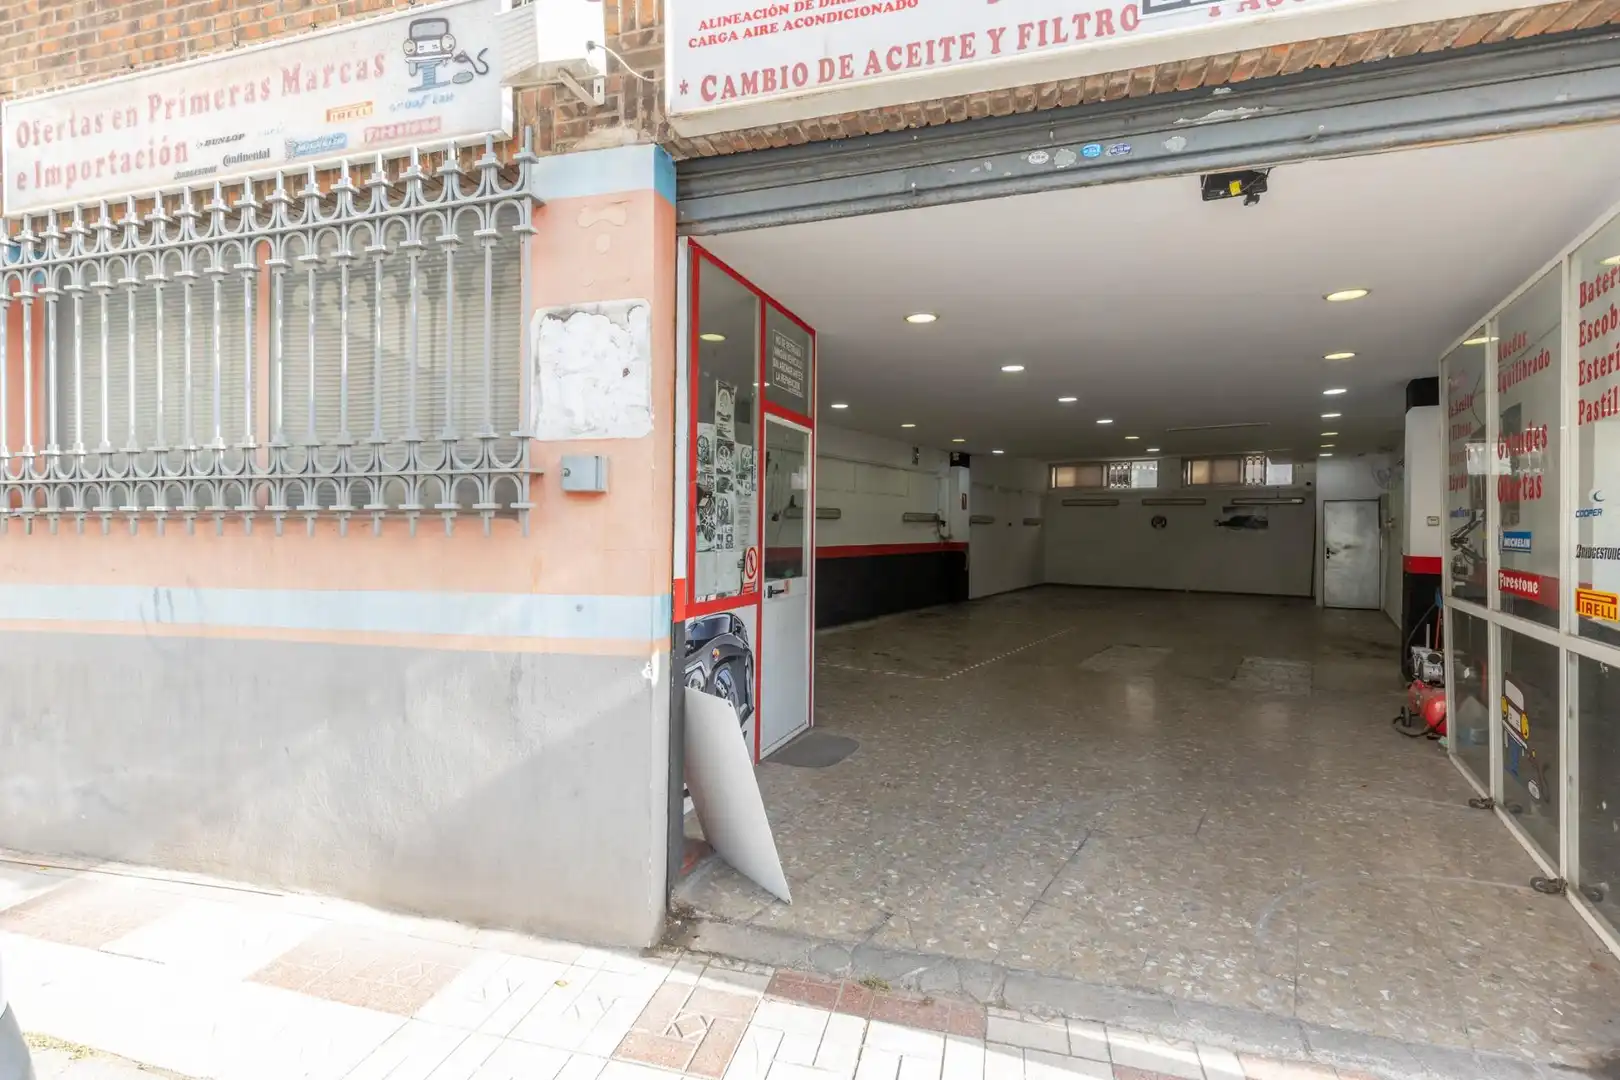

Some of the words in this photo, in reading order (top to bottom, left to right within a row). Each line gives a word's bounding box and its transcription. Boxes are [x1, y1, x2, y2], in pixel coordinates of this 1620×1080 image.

[688, 31, 738, 49] CARGA
[743, 22, 779, 39] AIRE
[783, 0, 919, 32] ACONDICIONADO
[698, 5, 790, 31] ALINEACIÓN
[793, 0, 816, 13] DE
[700, 62, 809, 102] CAMBIO
[817, 54, 855, 84] DE
[863, 32, 976, 76] ACEITE
[986, 27, 1006, 54] Y
[1017, 4, 1140, 50] FILTRO
[16, 107, 104, 149] Ofertas
[112, 105, 138, 130] en
[147, 75, 271, 122] Primeras
[281, 53, 386, 97] Marcas
[203, 133, 245, 147] DUNLOP
[223, 148, 270, 167] Continental
[17, 171, 27, 190] e
[34, 136, 188, 190] Importación
[1579, 263, 1620, 309] Bater
[1579, 303, 1620, 348] Escob
[1498, 347, 1550, 393] Equilibrado
[1578, 385, 1620, 426] Pastil
[1575, 508, 1603, 518] COOPER
[1503, 537, 1531, 549] MICHELIN
[1499, 573, 1539, 595] Firestone
[1577, 591, 1618, 621] PIRELLI
